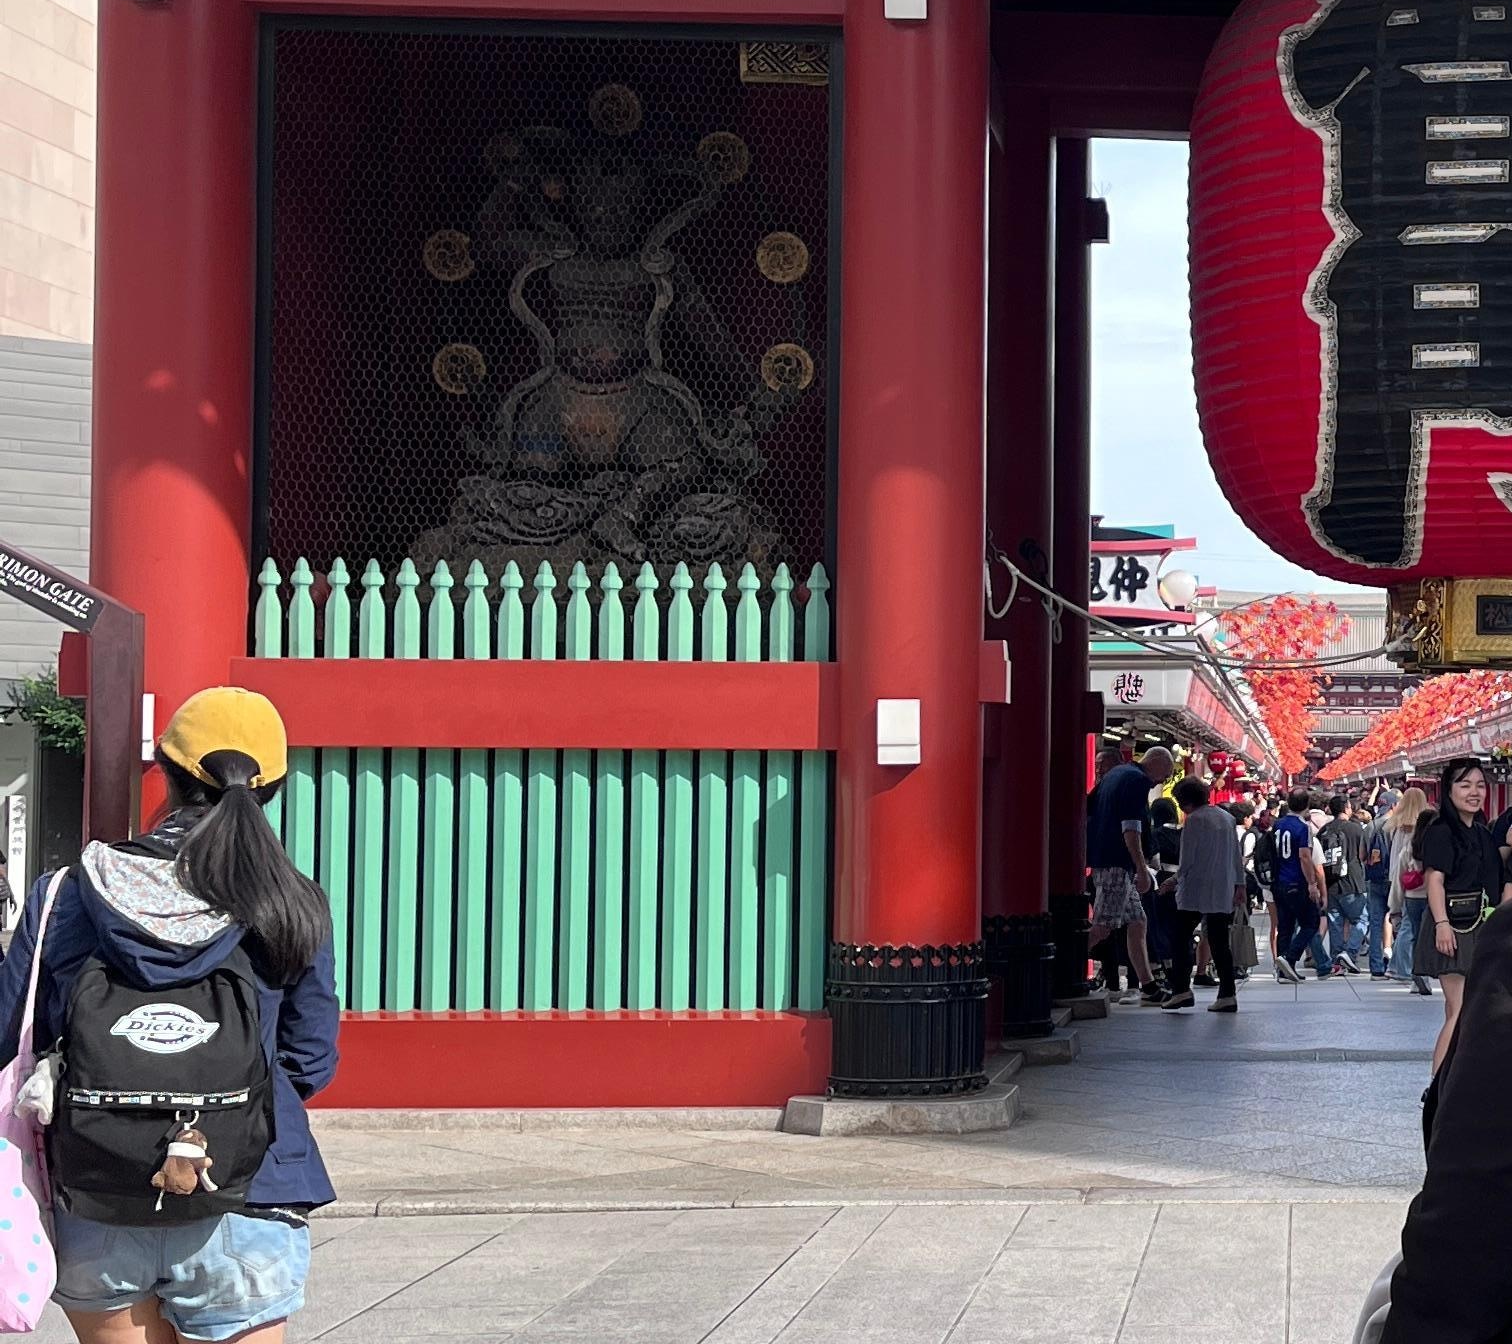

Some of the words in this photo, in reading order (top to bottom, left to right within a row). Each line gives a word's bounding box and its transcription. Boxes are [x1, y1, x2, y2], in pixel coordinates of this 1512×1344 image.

[49, 582, 94, 612] GATE
[1275, 829, 1292, 860] 10
[126, 1020, 207, 1034] Dickies
